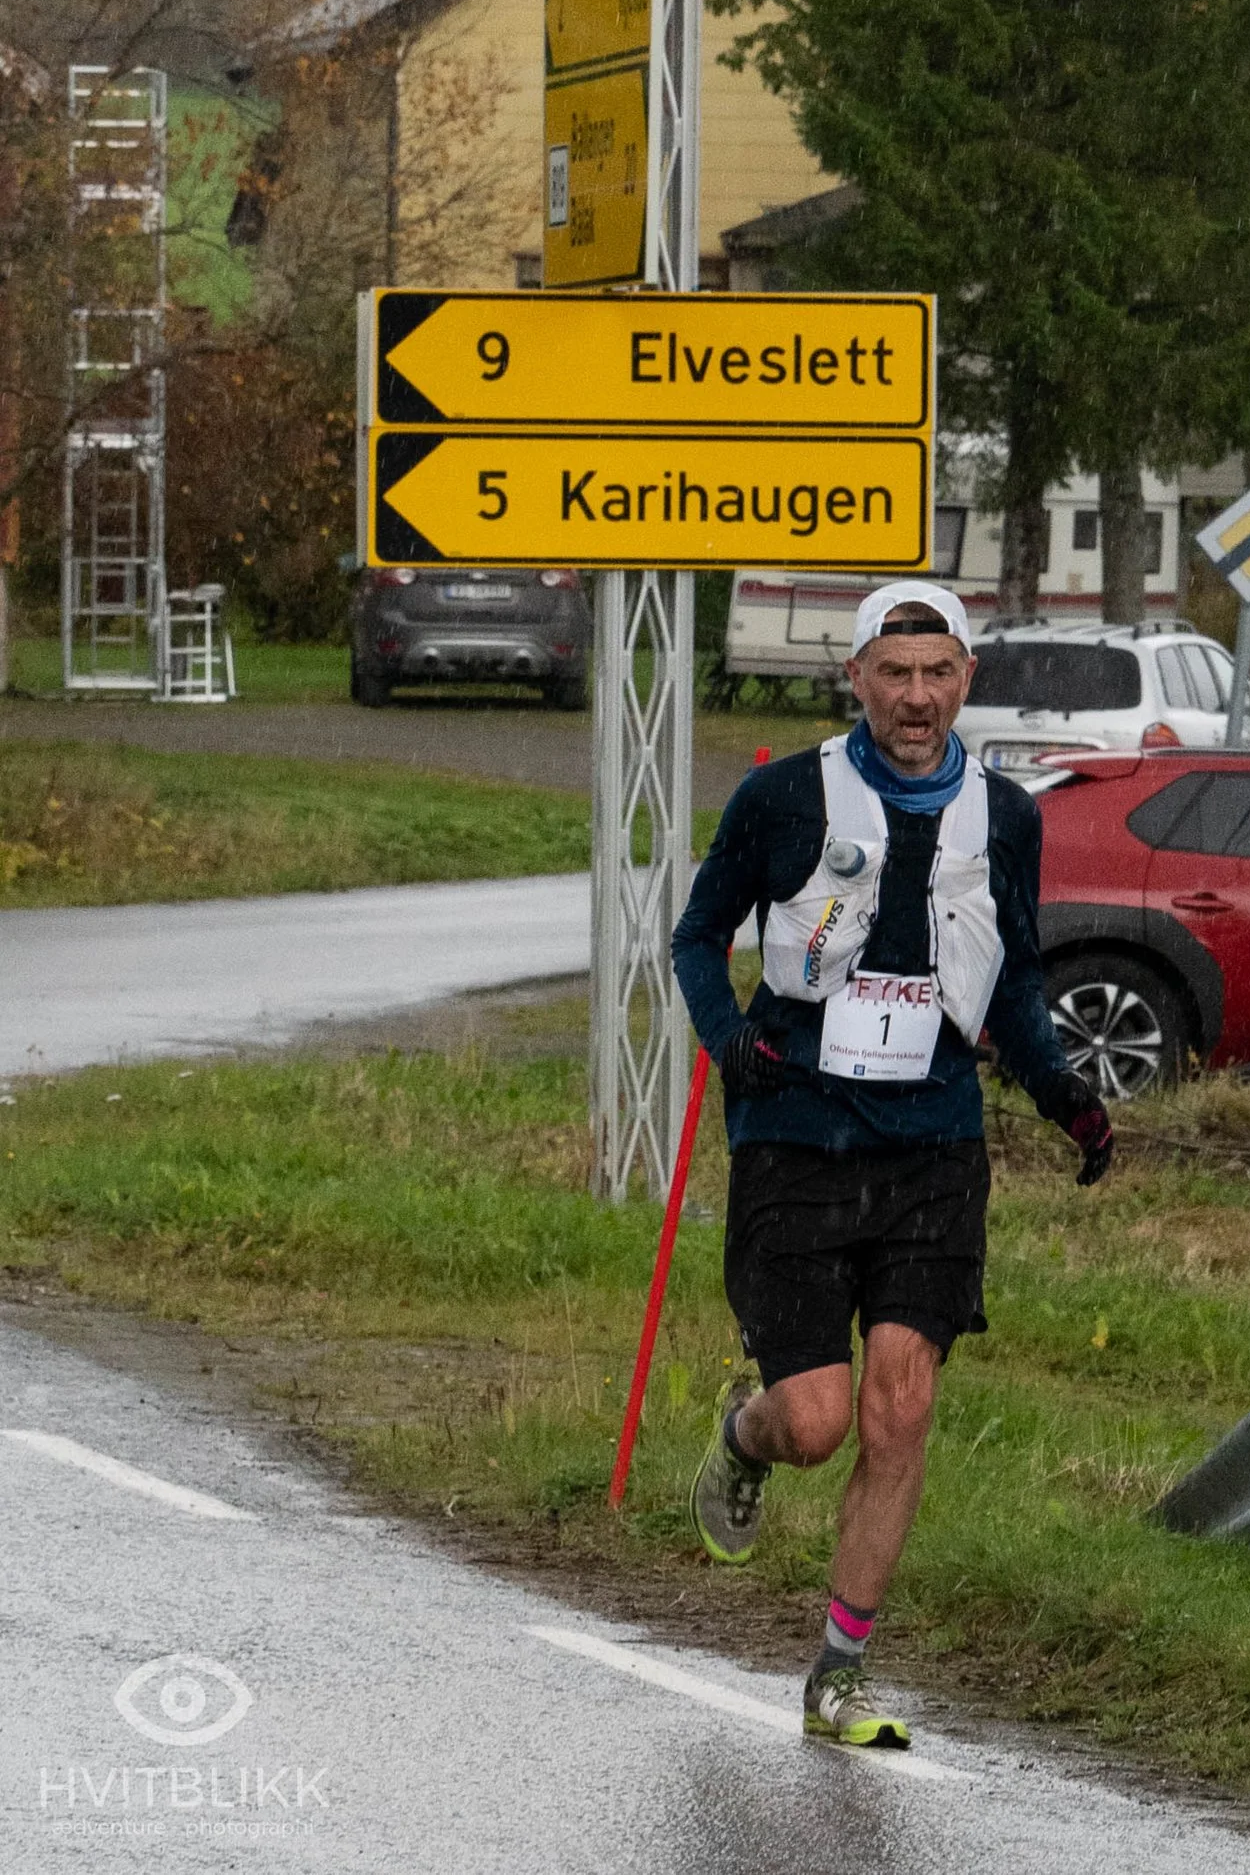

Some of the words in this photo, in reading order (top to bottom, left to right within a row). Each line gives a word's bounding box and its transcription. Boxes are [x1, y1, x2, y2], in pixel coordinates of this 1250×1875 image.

[477, 331, 511, 382] 9
[630, 331, 894, 386] Elveslett
[477, 471, 509, 521] 5
[561, 469, 892, 537] Karihaugen
[807, 899, 844, 988] SALOMON
[857, 977, 931, 1004] FYKE
[879, 1013, 891, 1046] 1
